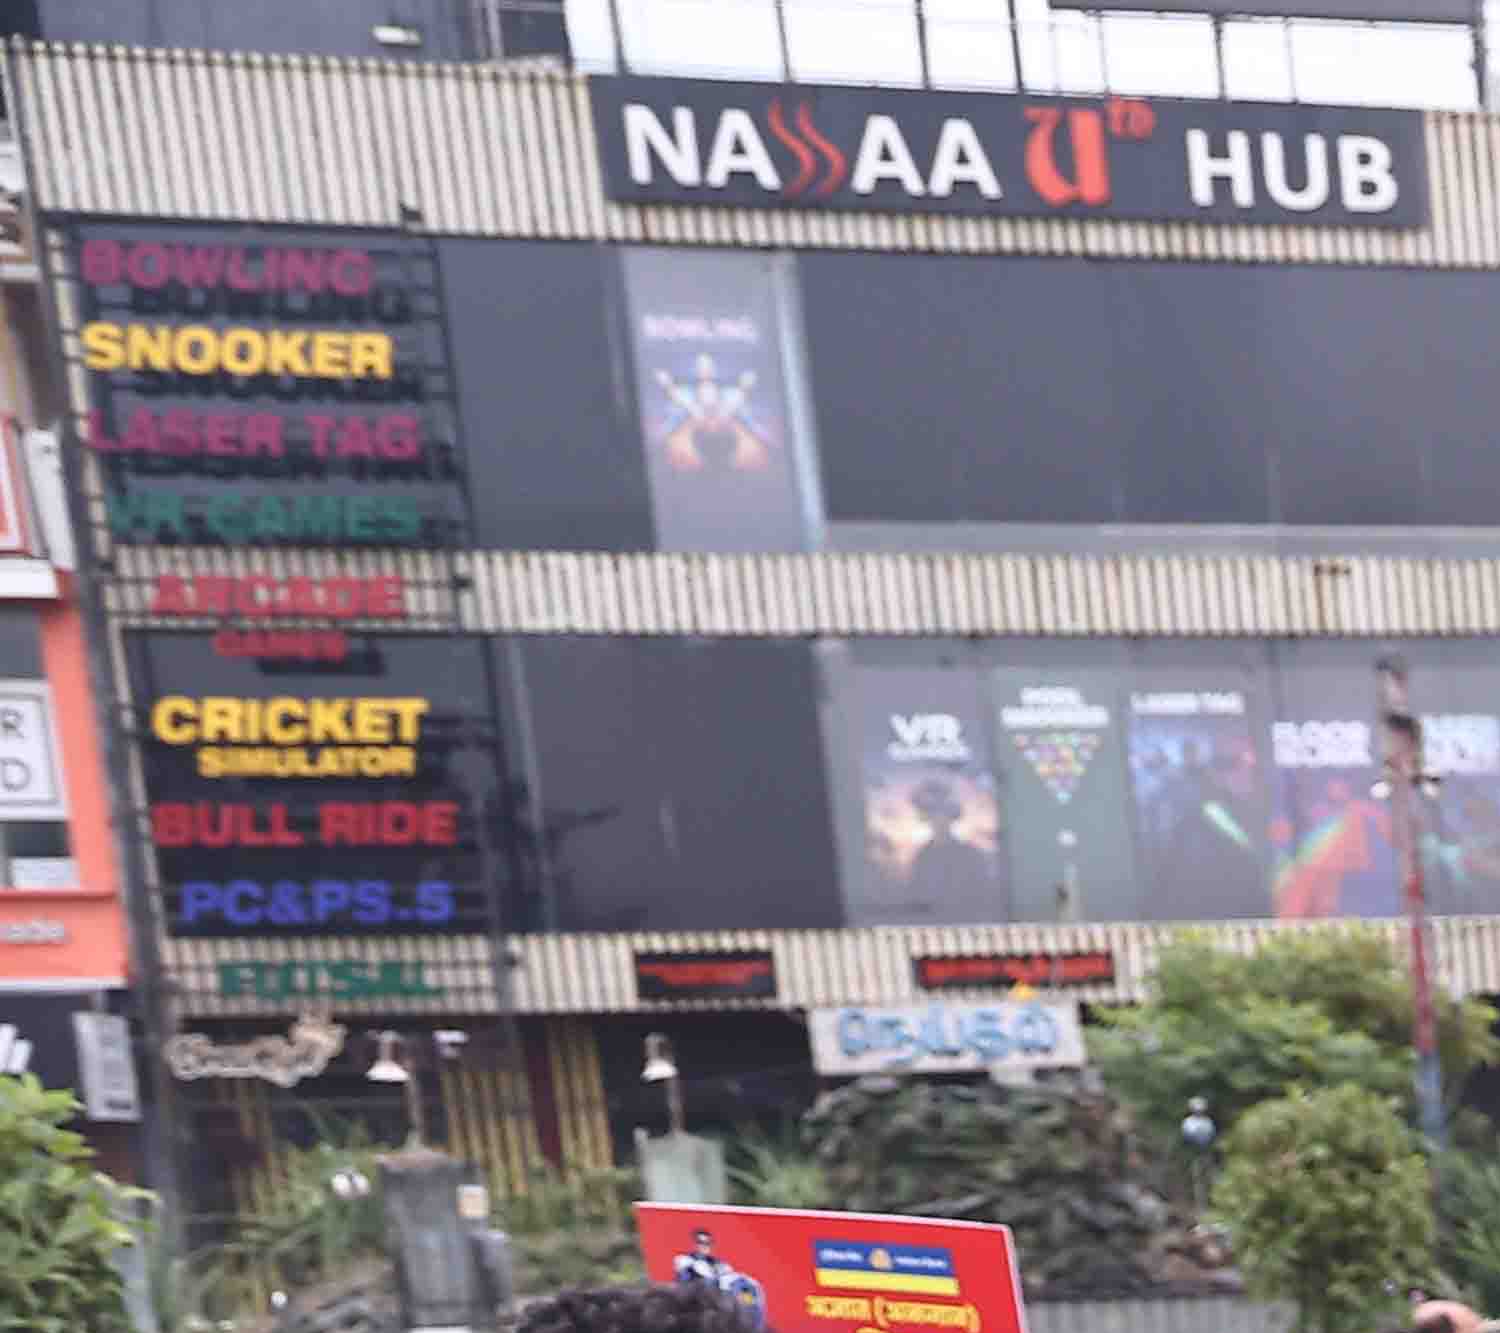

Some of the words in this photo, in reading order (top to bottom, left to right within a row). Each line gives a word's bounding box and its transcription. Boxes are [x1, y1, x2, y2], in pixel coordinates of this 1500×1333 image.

[1185, 129, 1400, 212] HUB
[83, 239, 373, 295] BOWLING
[82, 323, 393, 381] SNOOKER
[91, 410, 284, 460] LASER
[309, 413, 422, 462] TAG
[151, 695, 429, 747] CRICKET
[198, 746, 416, 779] SIMULATOR
[150, 801, 305, 847] BULL
[319, 802, 460, 847] RIDE
